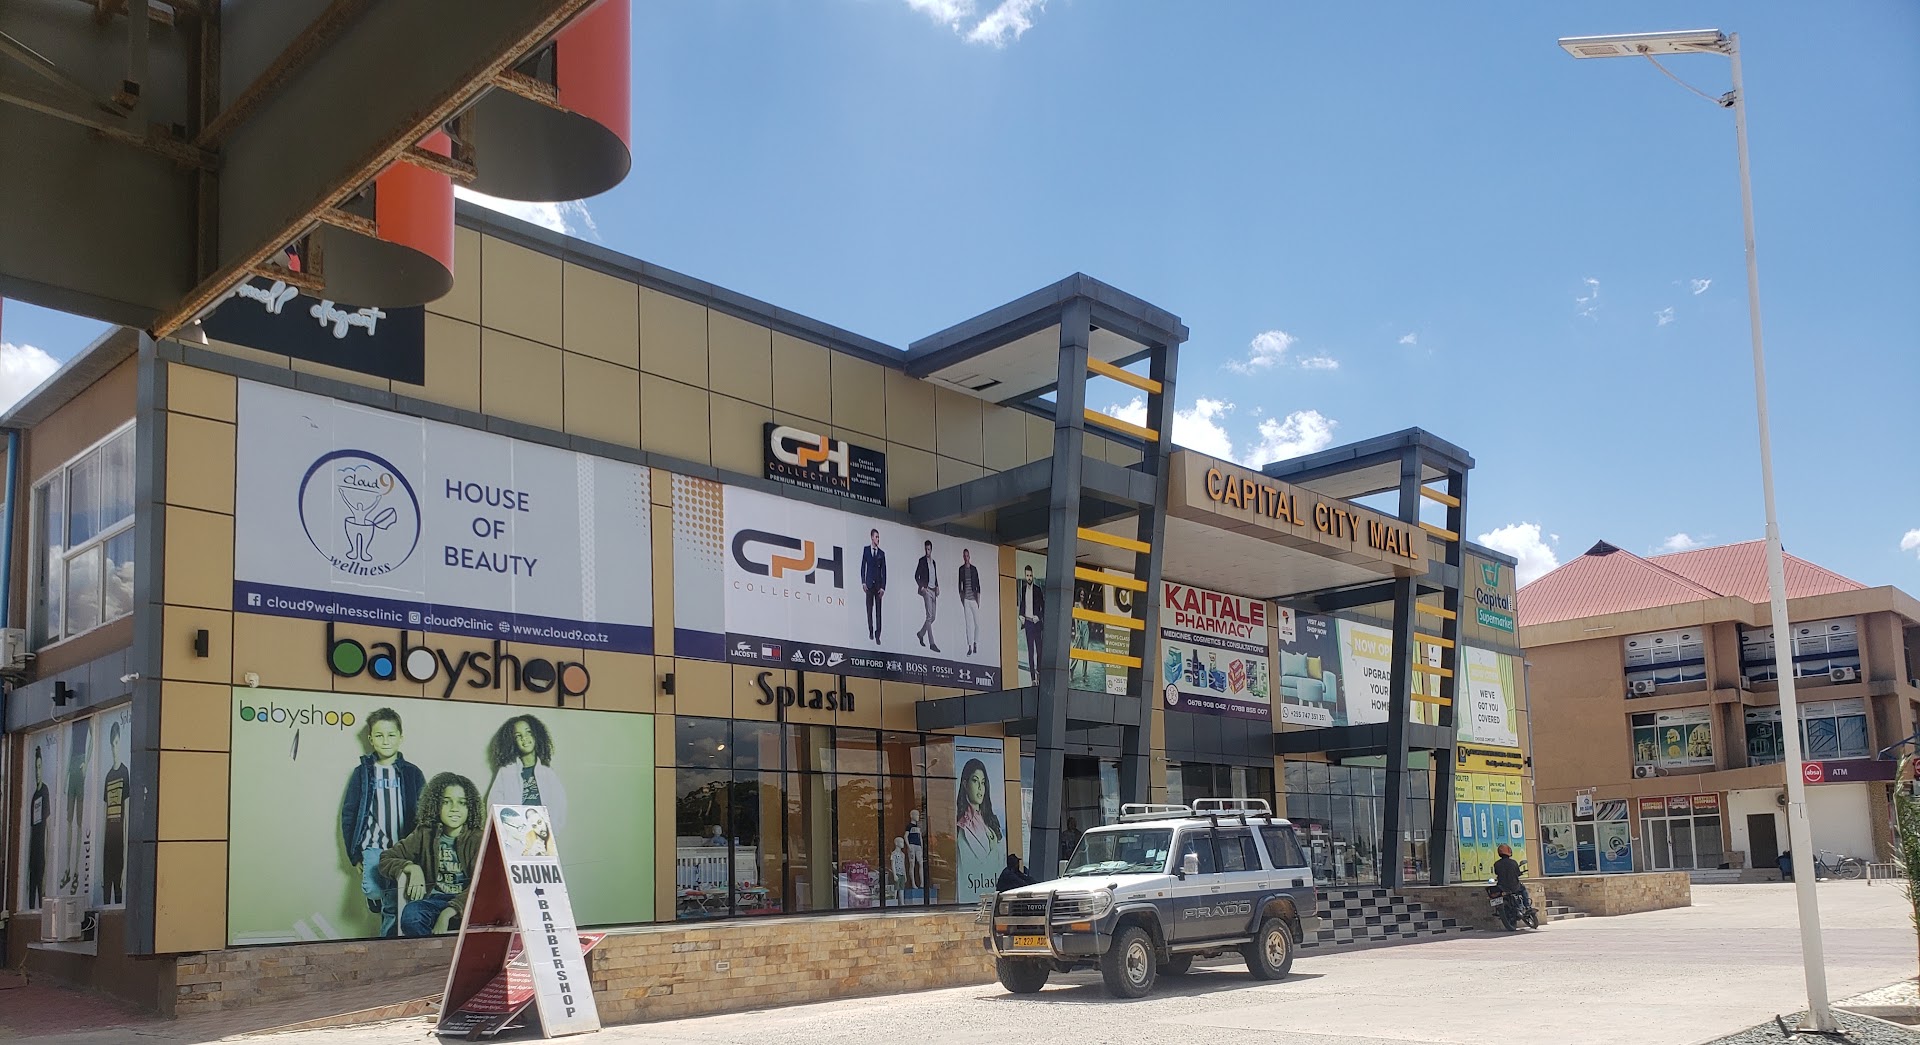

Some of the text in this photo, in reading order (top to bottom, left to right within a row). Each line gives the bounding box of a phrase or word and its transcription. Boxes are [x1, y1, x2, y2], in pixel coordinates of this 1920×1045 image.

[771, 426, 848, 478] CPH
[770, 462, 846, 488] COLLECTION
[445, 478, 530, 512] HOUSE
[770, 474, 796, 486] PREMIUM
[797, 481, 812, 489] MENS
[812, 484, 834, 494] BRITISH
[834, 490, 850, 498] STYLE
[857, 494, 882, 506] TANZANIA
[1207, 468, 1418, 560] CAPITAL CITY MALL
[472, 517, 506, 540] OF
[330, 554, 392, 577] wellness
[444, 546, 538, 578] BEAUTY
[732, 528, 844, 588] CPH
[734, 581, 845, 606] COLLECTION
[1165, 583, 1264, 627] KAITALE
[1476, 588, 1509, 611] Capital
[266, 596, 403, 622] cloud9wellnessclinic
[1480, 610, 1512, 630] Supermarket
[424, 614, 494, 632] cloud9clinic
[513, 624, 609, 644] www.cloud9.co.tz
[1176, 612, 1254, 639] PHARMACY
[730, 650, 758, 659] LACOSTE
[830, 652, 844, 660] NIKE
[1354, 638, 1376, 653] NOW
[326, 622, 591, 706] babyshop
[850, 658, 884, 668] TOM FORD
[906, 662, 928, 672] BOSS
[932, 665, 954, 675] FOSSIL
[976, 676, 992, 687] PUMA
[1370, 684, 1389, 696] YOUR
[756, 670, 855, 722] Splash
[1480, 690, 1496, 700] WE'VE
[240, 700, 356, 730] babyshop
[1478, 702, 1499, 712] GOT YOU
[1478, 714, 1500, 724] COVERED
[1806, 767, 1820, 776] absa
[510, 864, 562, 884] SAUNA
[1183, 904, 1251, 920] PRADO
[538, 900, 576, 1018] BARBERSHOP
